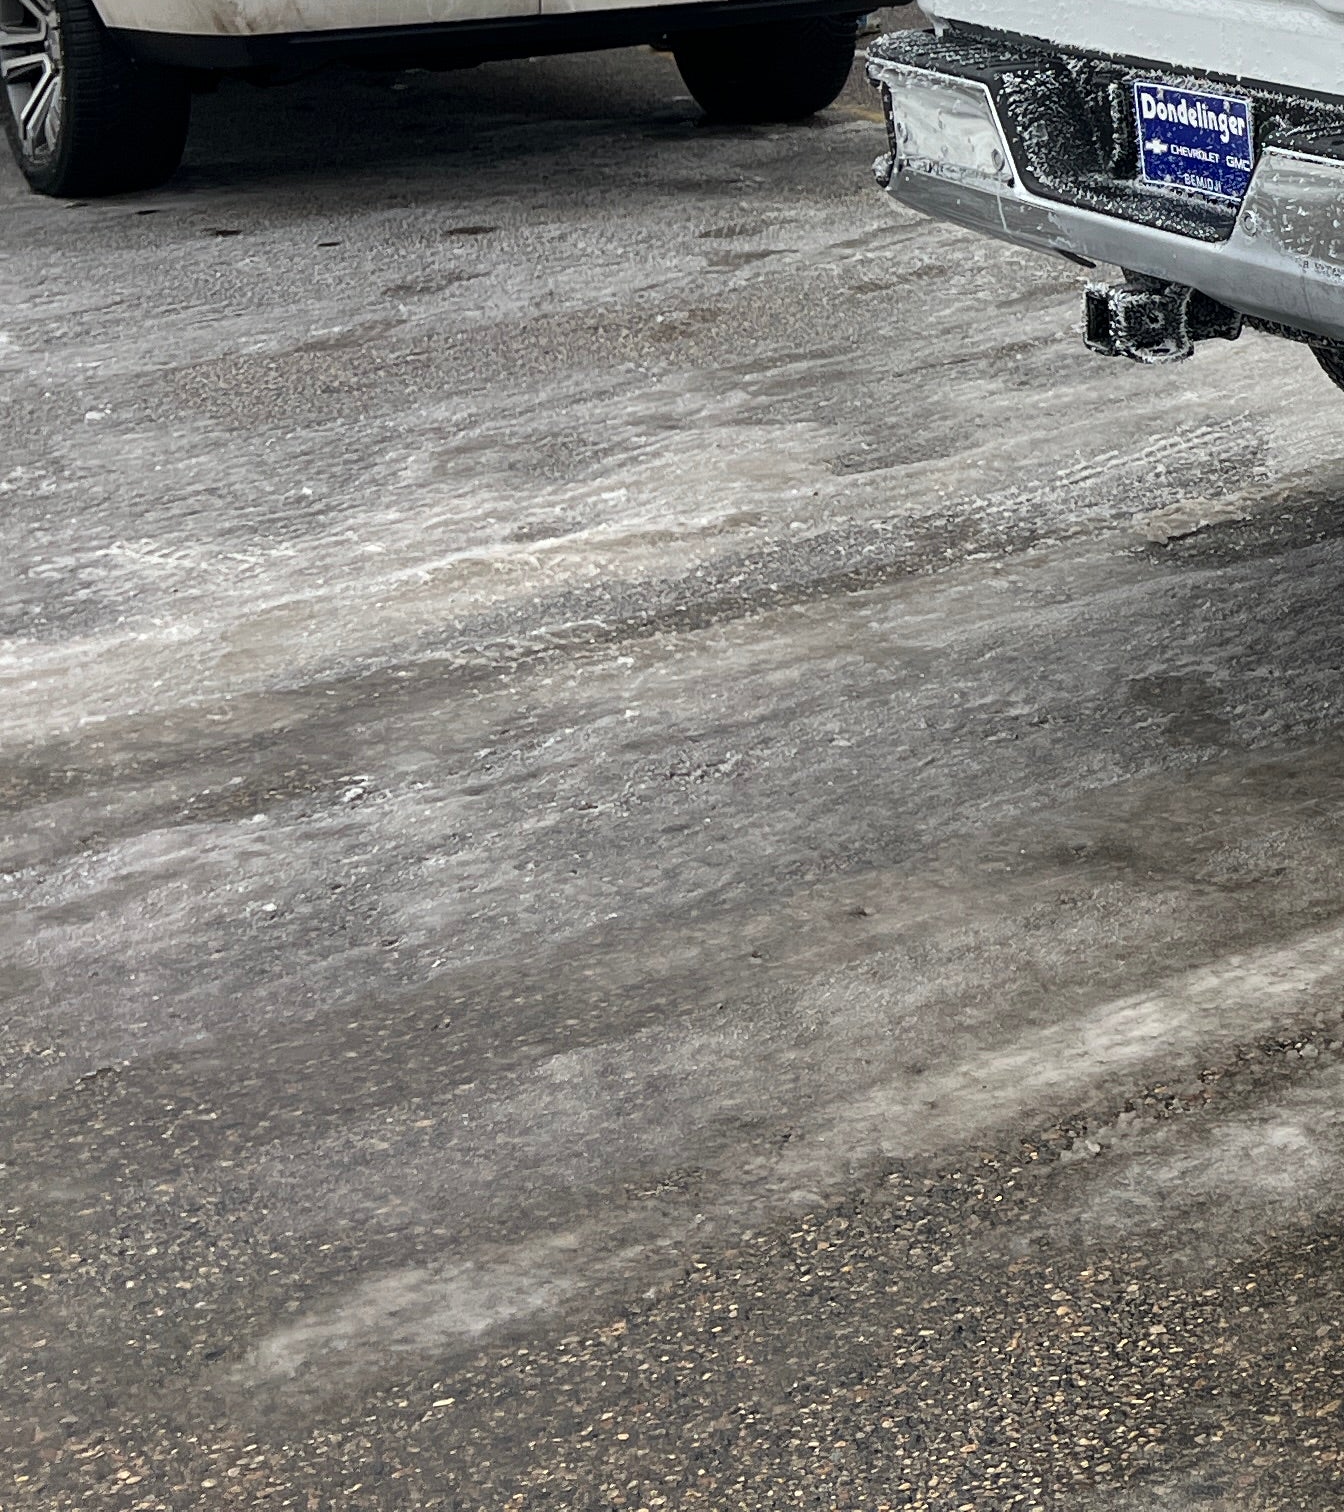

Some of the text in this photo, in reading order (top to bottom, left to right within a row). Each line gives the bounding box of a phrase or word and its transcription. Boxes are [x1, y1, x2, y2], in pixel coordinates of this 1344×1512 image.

[1140, 92, 1246, 144] Dondelinger
[1170, 143, 1252, 172] CHEVROLET GMC
[1184, 173, 1222, 193] BEMIDJI
